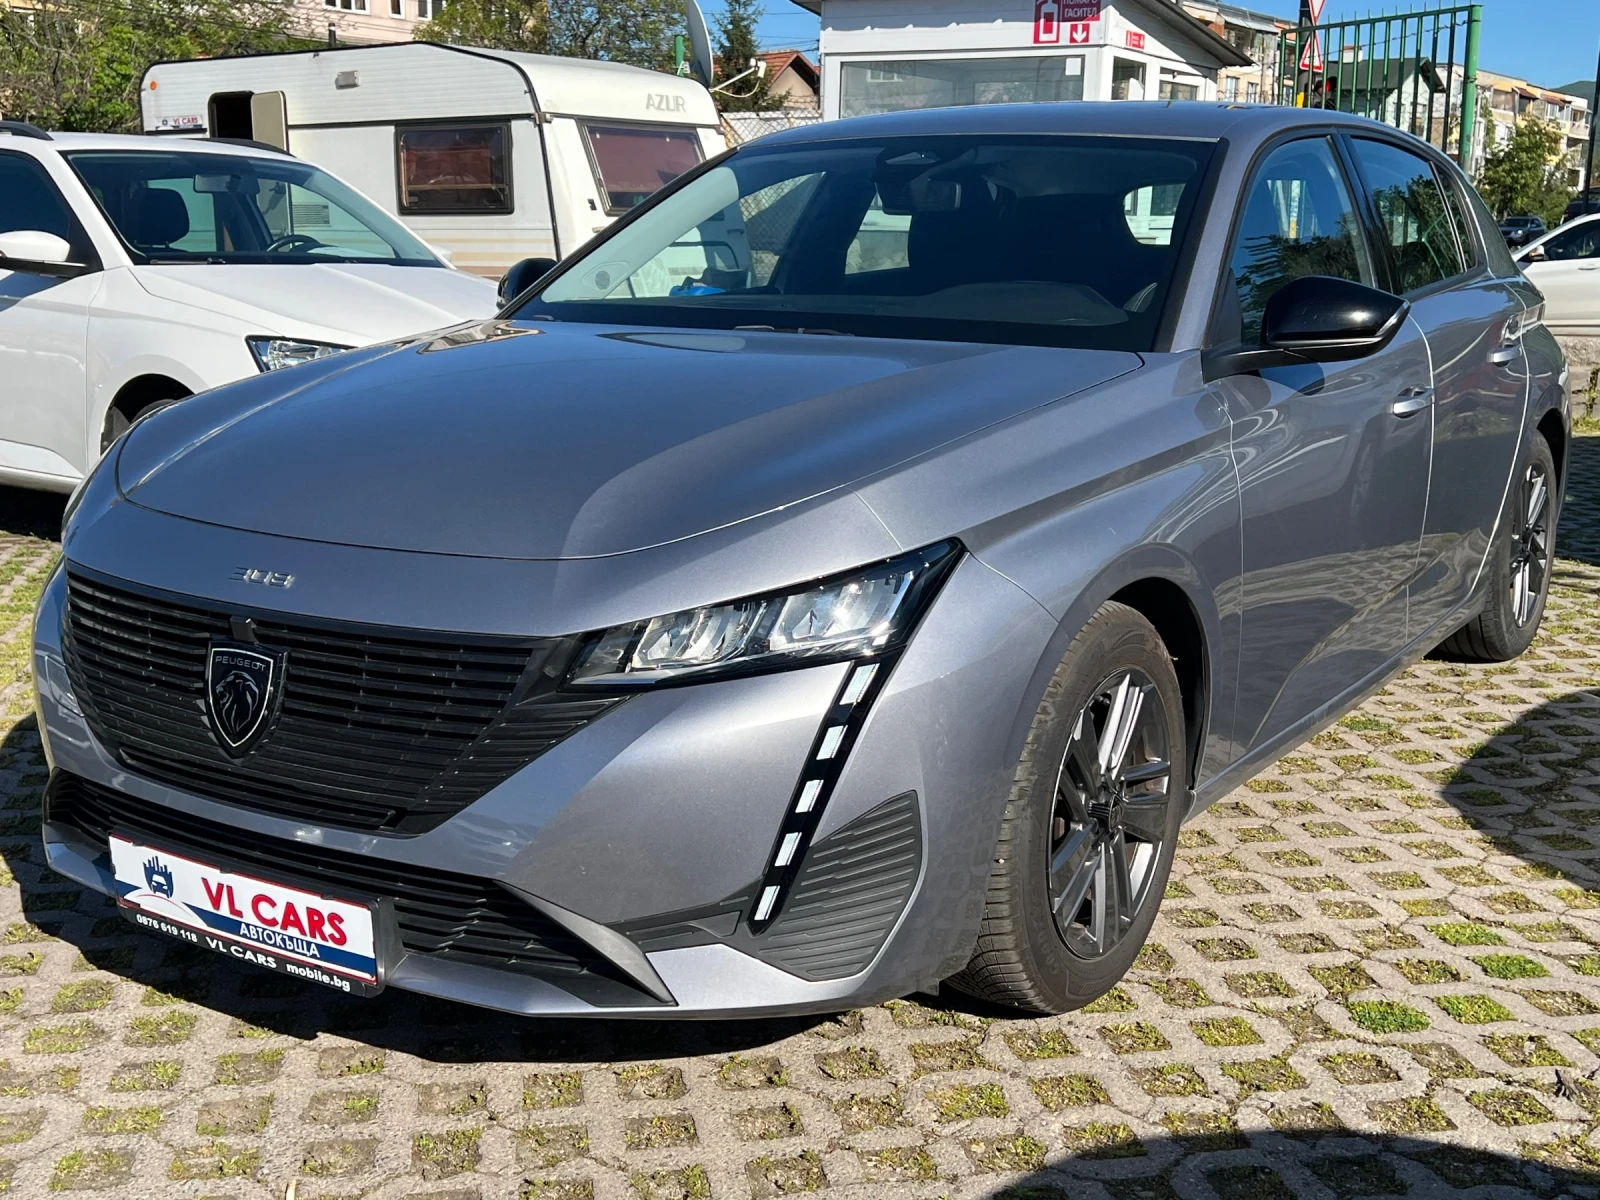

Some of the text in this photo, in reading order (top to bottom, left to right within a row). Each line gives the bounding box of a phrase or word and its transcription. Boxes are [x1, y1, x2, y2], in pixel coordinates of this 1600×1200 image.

[1064, 7, 1097, 18] ГАСИТЕЛ
[645, 93, 687, 113] AZUR
[228, 566, 294, 589] 308
[215, 655, 267, 672] PEUGEOT
[201, 877, 348, 946] VL CARS
[239, 922, 320, 958] АВТОКЪЩА
[136, 913, 351, 992] 0876 619 118 VL CARS mobile.bg
